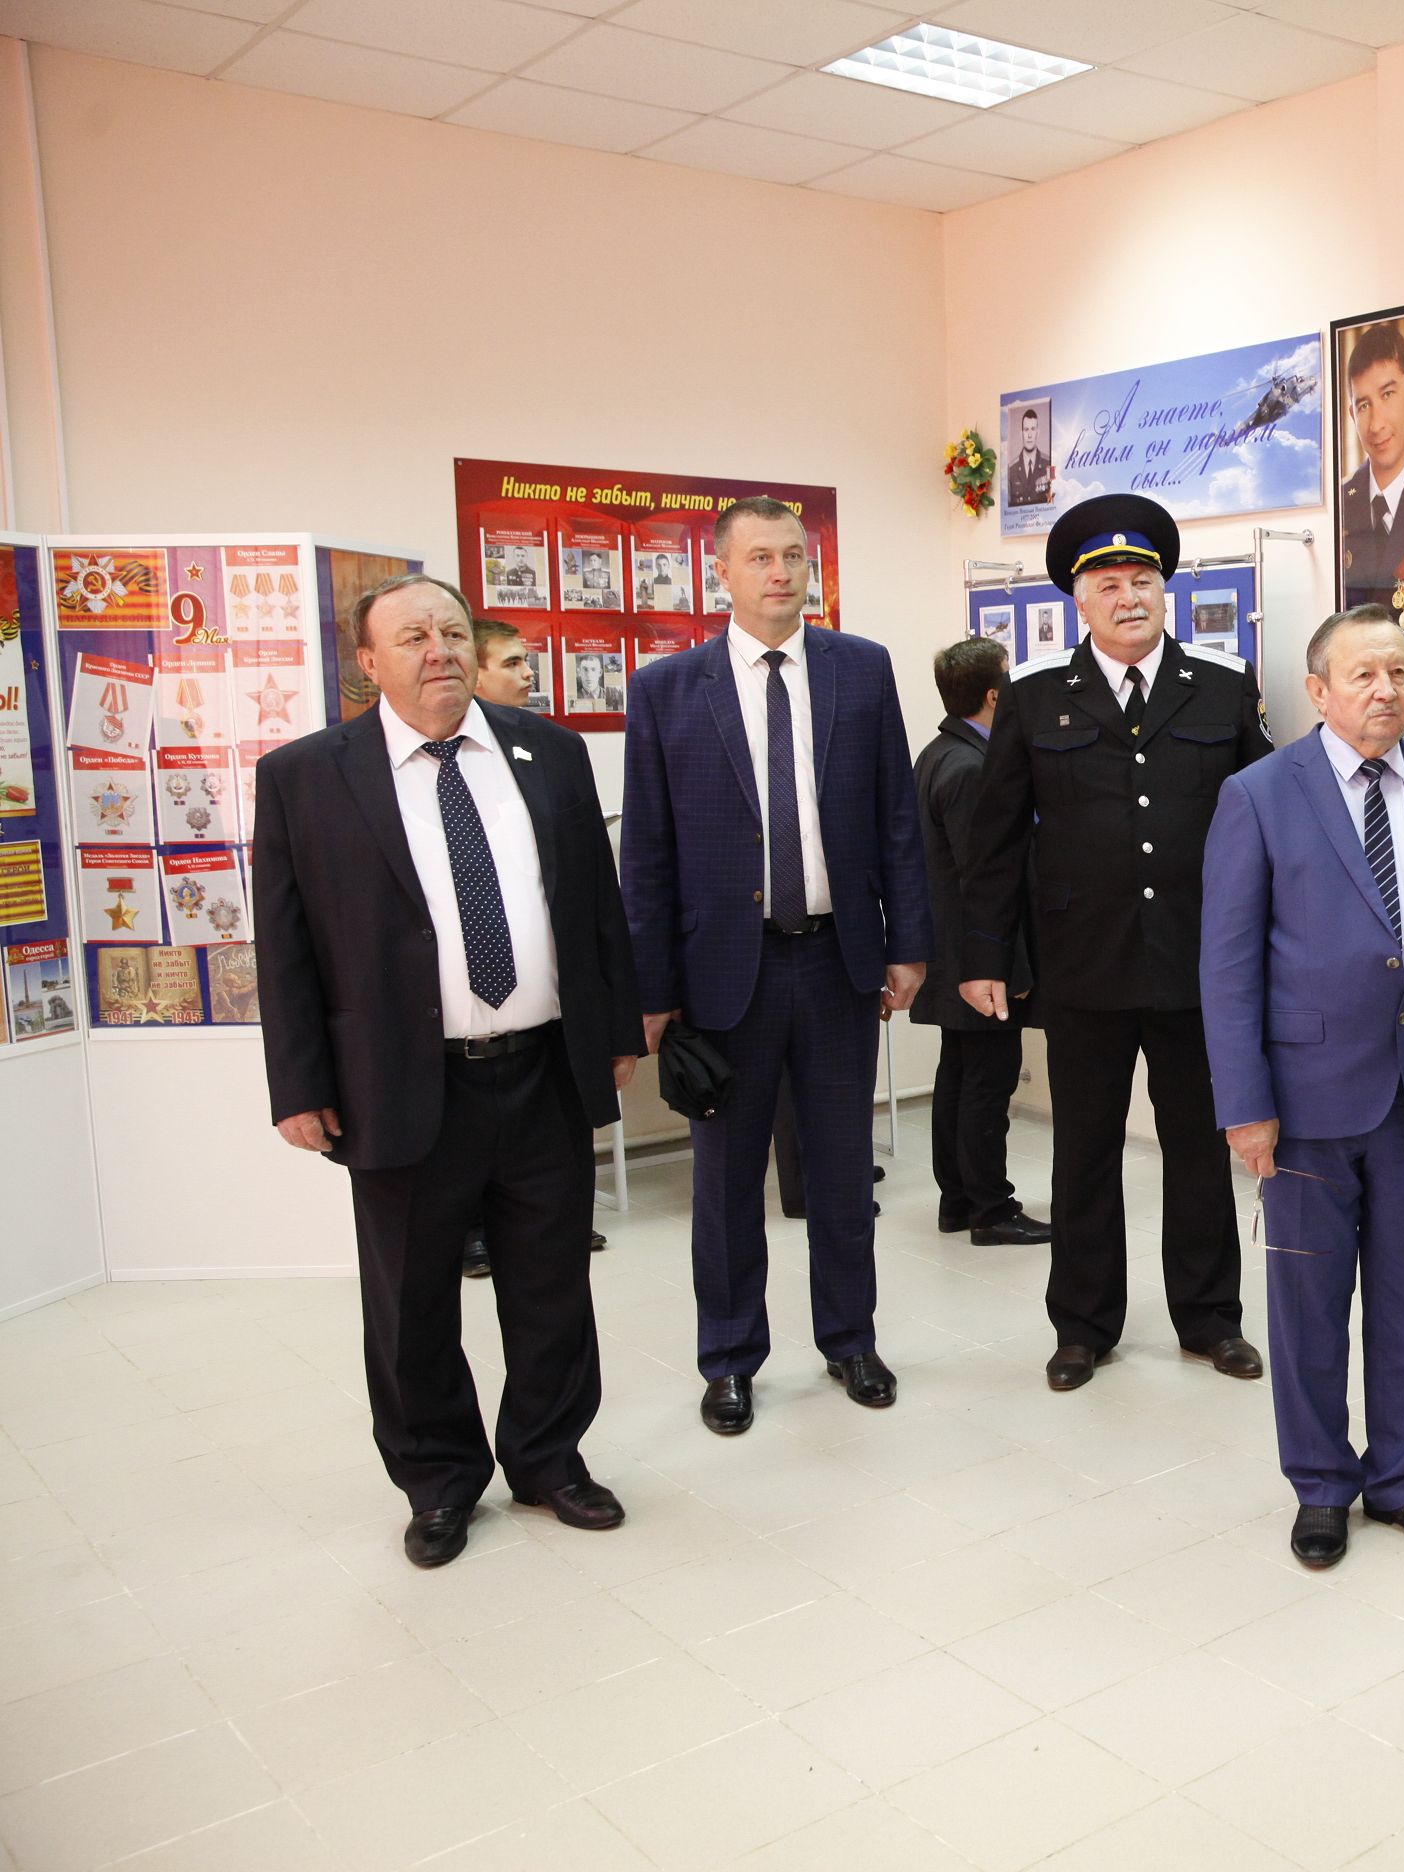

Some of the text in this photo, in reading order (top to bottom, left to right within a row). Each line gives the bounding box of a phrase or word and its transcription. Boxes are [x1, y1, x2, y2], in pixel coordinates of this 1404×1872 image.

[1094, 379, 1141, 435] А
[1065, 429, 1134, 470] каким
[1146, 438, 1171, 459] он
[501, 477, 561, 500] Никто
[566, 485, 587, 503] не
[592, 483, 655, 510] забыт,
[661, 492, 713, 511] ничто
[171, 592, 206, 645] 9
[191, 628, 231, 645] Мая
[79, 757, 103, 765] Орден
[165, 753, 187, 761] Орден
[169, 858, 192, 867] Орден
[22, 944, 55, 956] Одесса
[159, 949, 182, 957] Никто
[166, 960, 191, 968] забыт
[164, 979, 196, 989] забыто!
[106, 1011, 133, 1024] 1941
[172, 1010, 200, 1024] 1945
